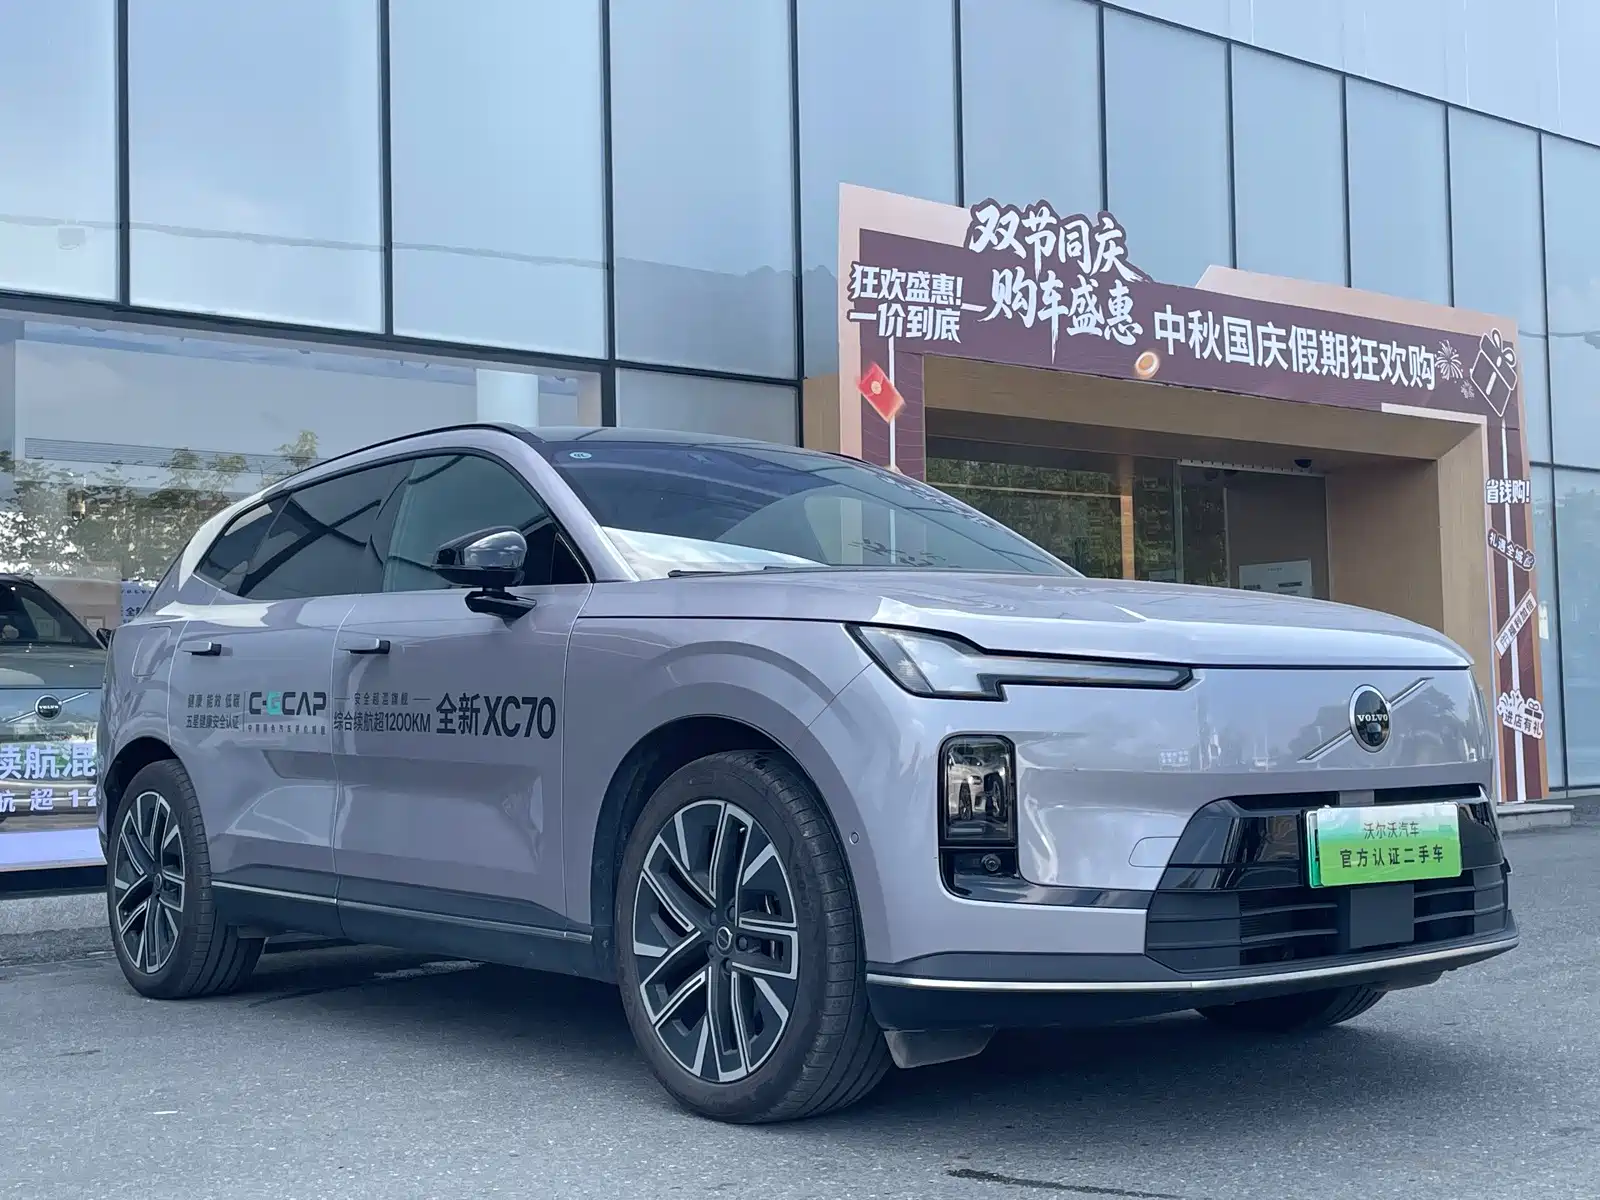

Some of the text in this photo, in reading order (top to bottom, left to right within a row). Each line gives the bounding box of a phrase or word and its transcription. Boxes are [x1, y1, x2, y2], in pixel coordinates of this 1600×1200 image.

[968, 203, 1148, 284] 双节同庆
[851, 264, 964, 305] 狂欢盛惠!
[849, 302, 962, 344] 一价到底
[977, 266, 1144, 364] 购车盛惠
[1153, 304, 1436, 391] 中秋国庆假期狂欢购
[1486, 479, 1530, 504] 省钱购!
[333, 711, 432, 733] 综合续航超1200KM
[436, 692, 557, 740] 全新XC70
[1356, 713, 1390, 722] VOLVO
[1503, 710, 1542, 736] 进店有礼
[1363, 821, 1421, 840] 沃尔沃汽车
[1339, 844, 1444, 869] 官方认证二手车
